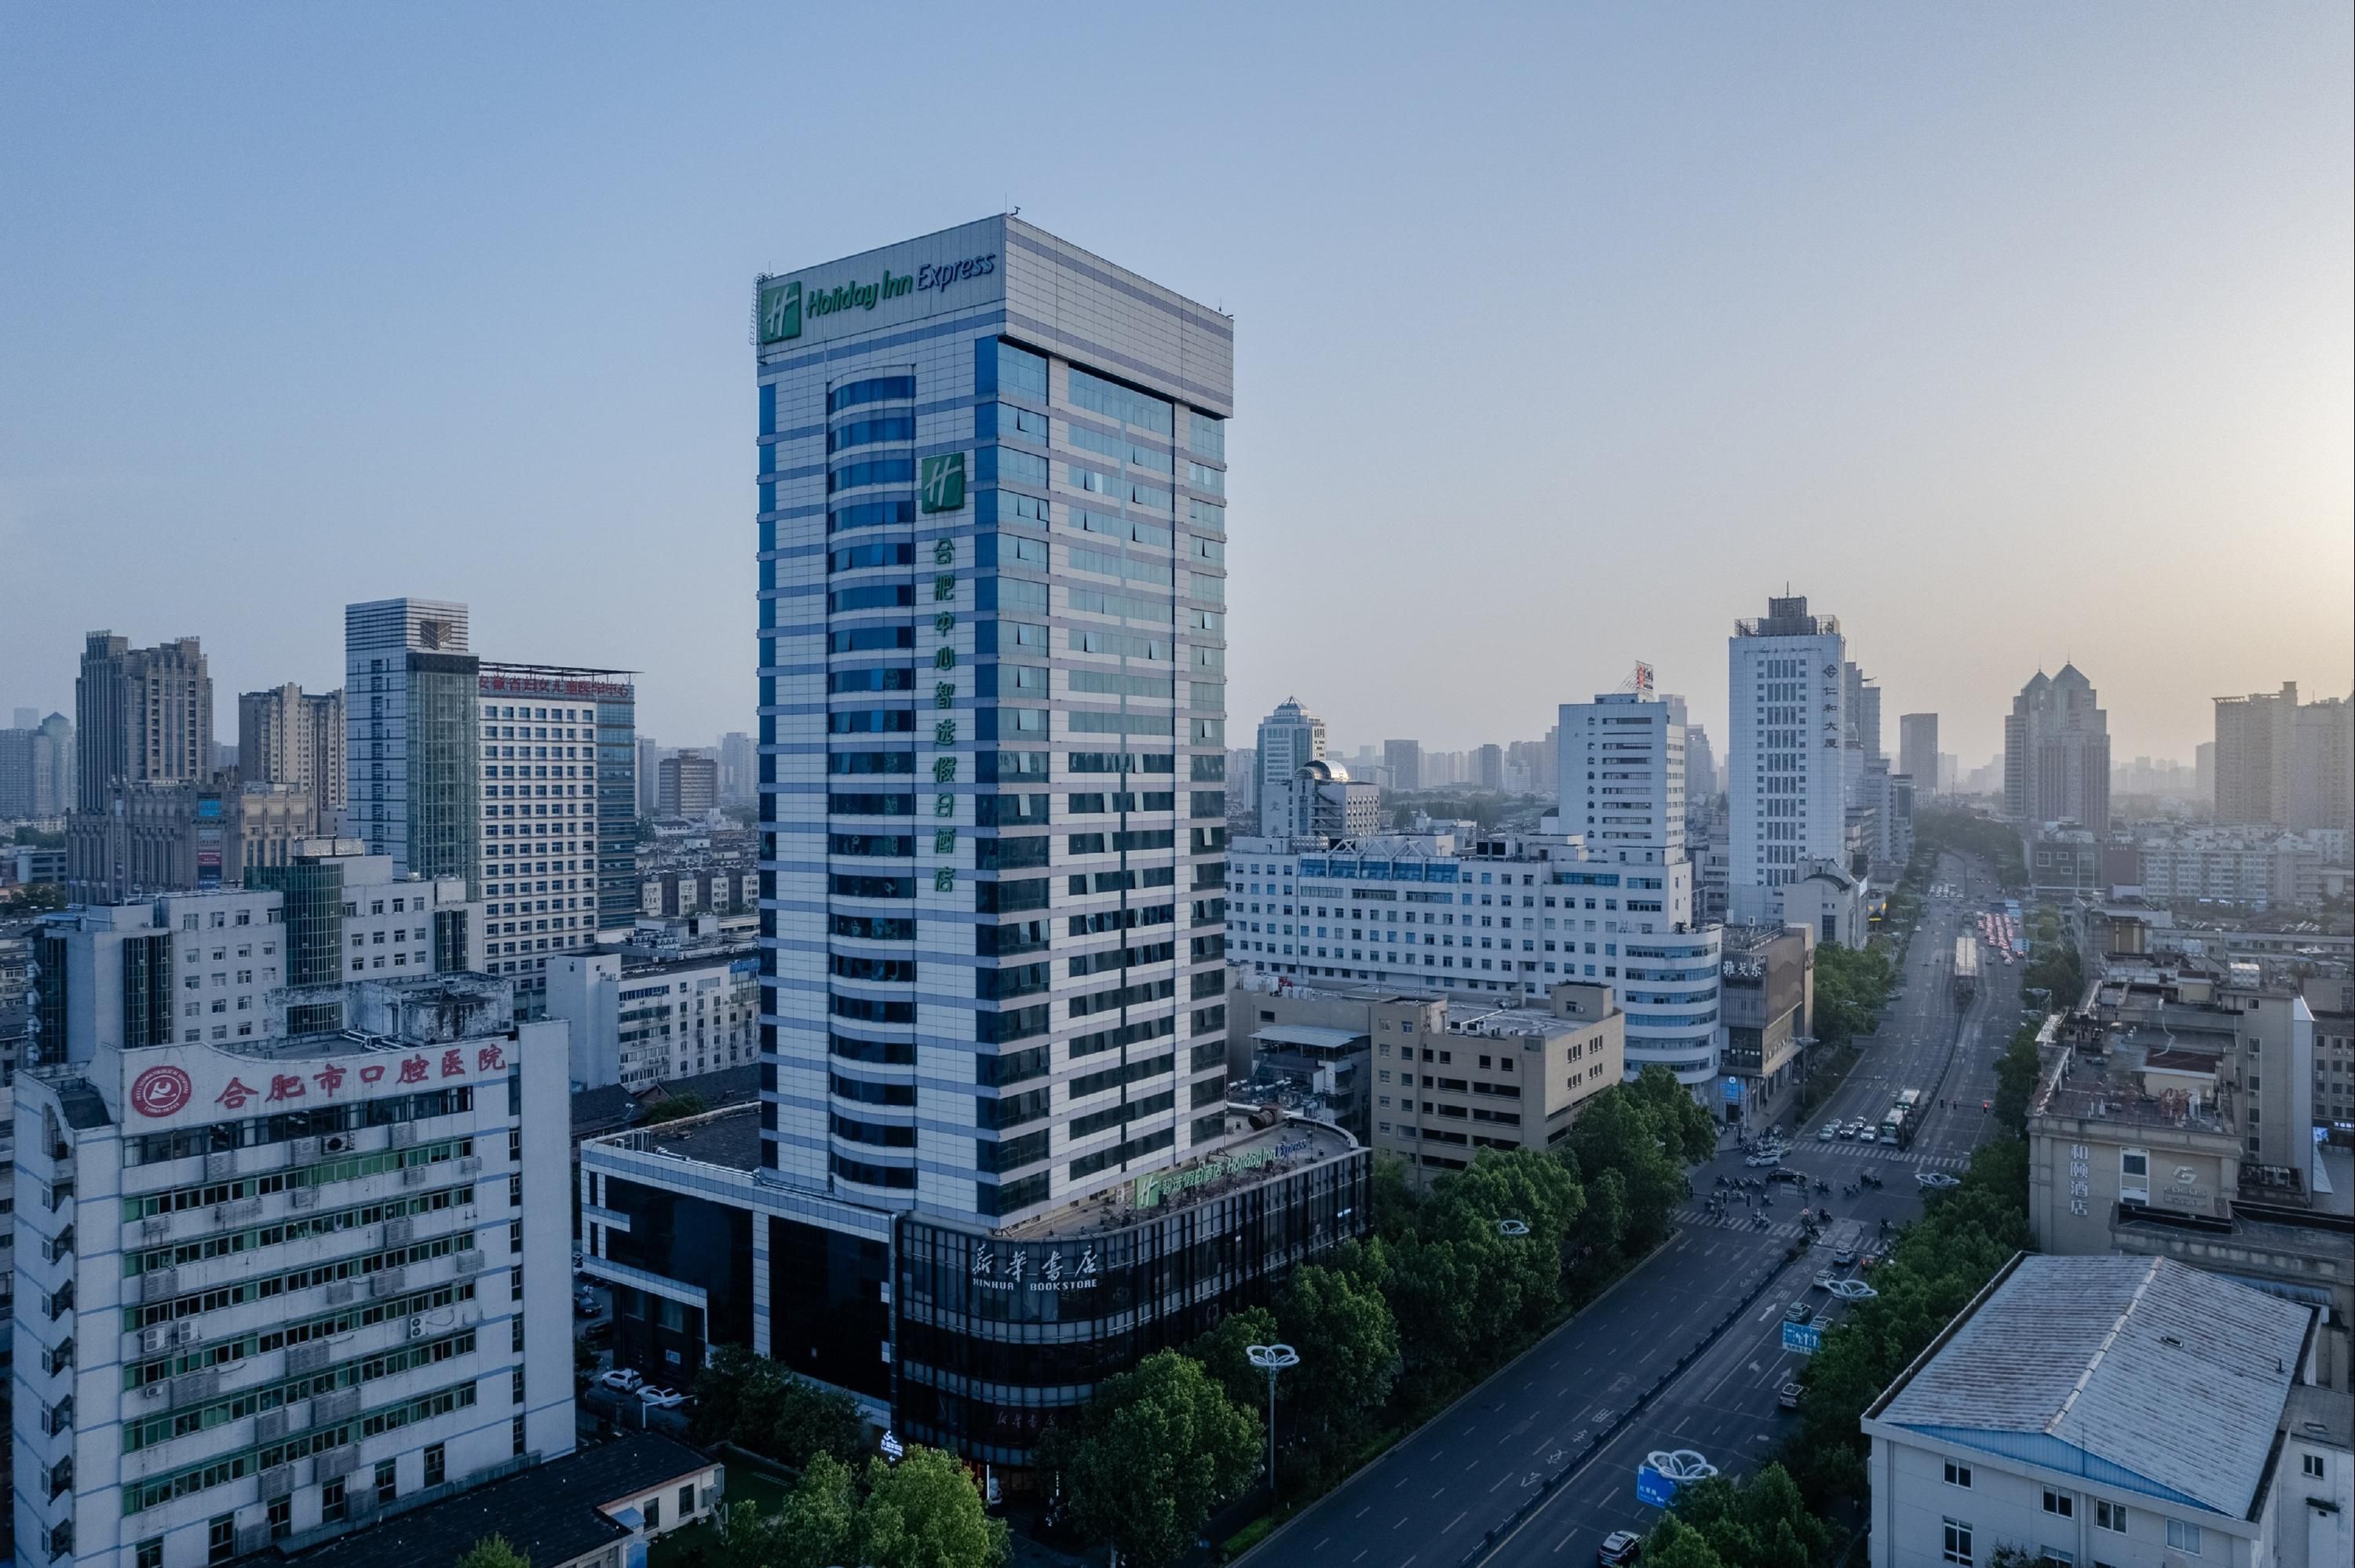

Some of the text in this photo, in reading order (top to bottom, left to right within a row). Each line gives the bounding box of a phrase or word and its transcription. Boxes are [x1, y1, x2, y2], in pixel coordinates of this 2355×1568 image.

[805, 253, 996, 319] Holiday Inn Express
[933, 538, 956, 892] 合肥中心智选假日酒店
[1822, 686, 1838, 749] 仁和大厦
[1722, 960, 1762, 978] 雅戈尔
[215, 1043, 507, 1110] 合肥市口腔医院
[1226, 1150, 1263, 1173] Holiday
[1261, 1148, 1276, 1163] Inn
[2069, 1143, 2089, 1216] 和颐酒店
